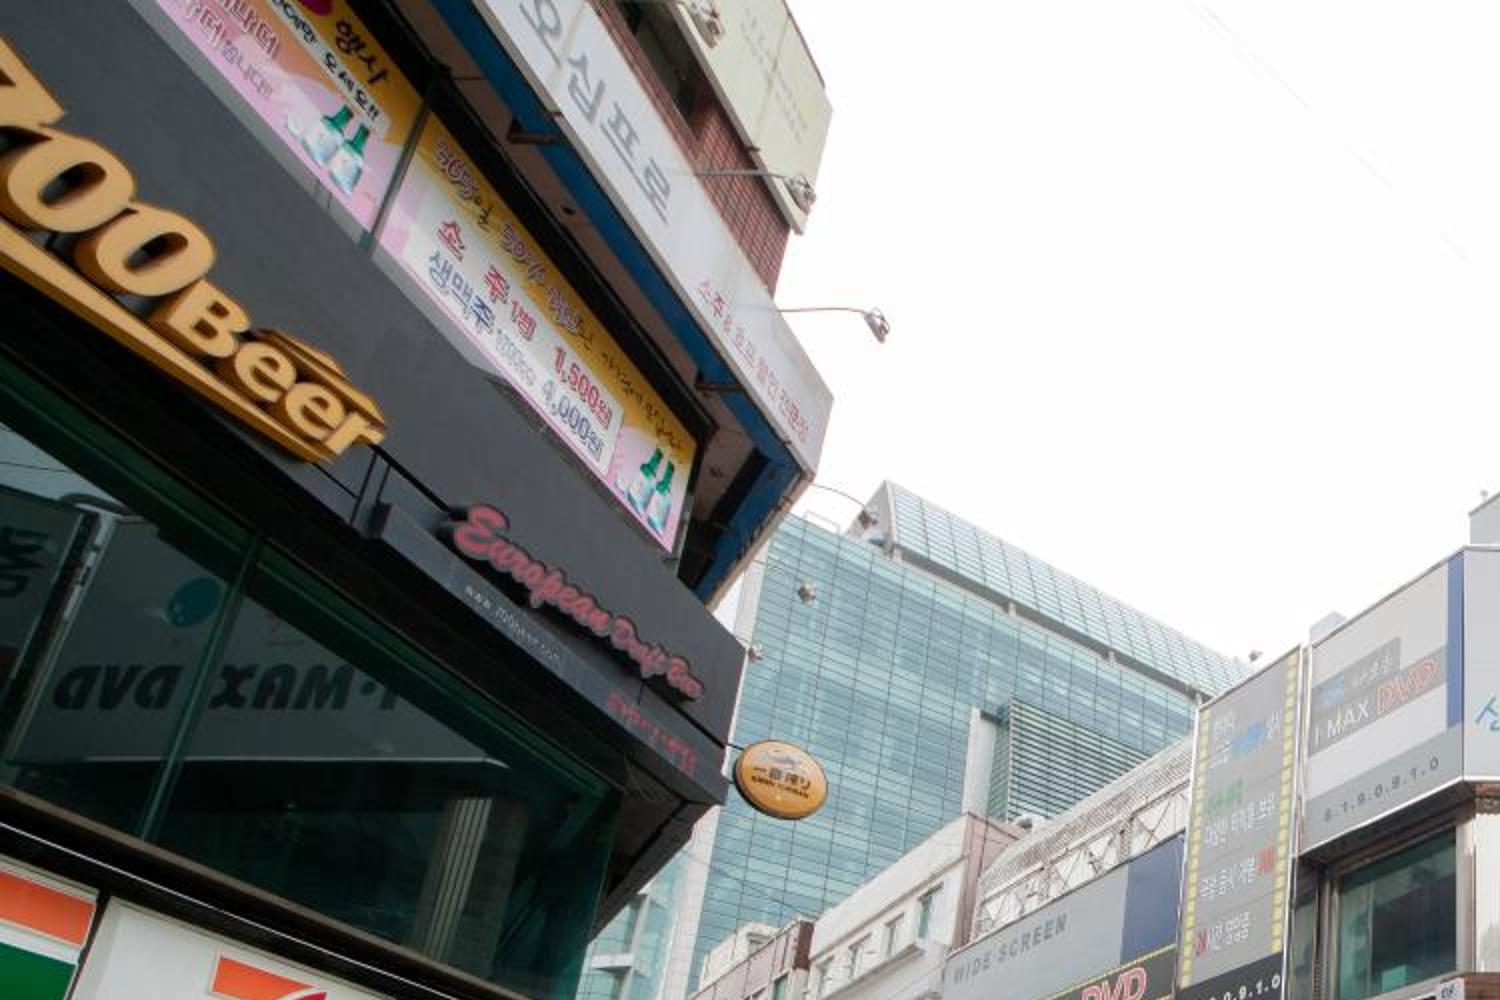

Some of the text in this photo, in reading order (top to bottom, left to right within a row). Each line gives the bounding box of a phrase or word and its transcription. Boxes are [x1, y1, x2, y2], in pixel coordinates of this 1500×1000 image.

[1327, 702, 1369, 739] MAX
[1375, 658, 1440, 715] DVD
[953, 914, 1067, 985] WIDE SCREEN
